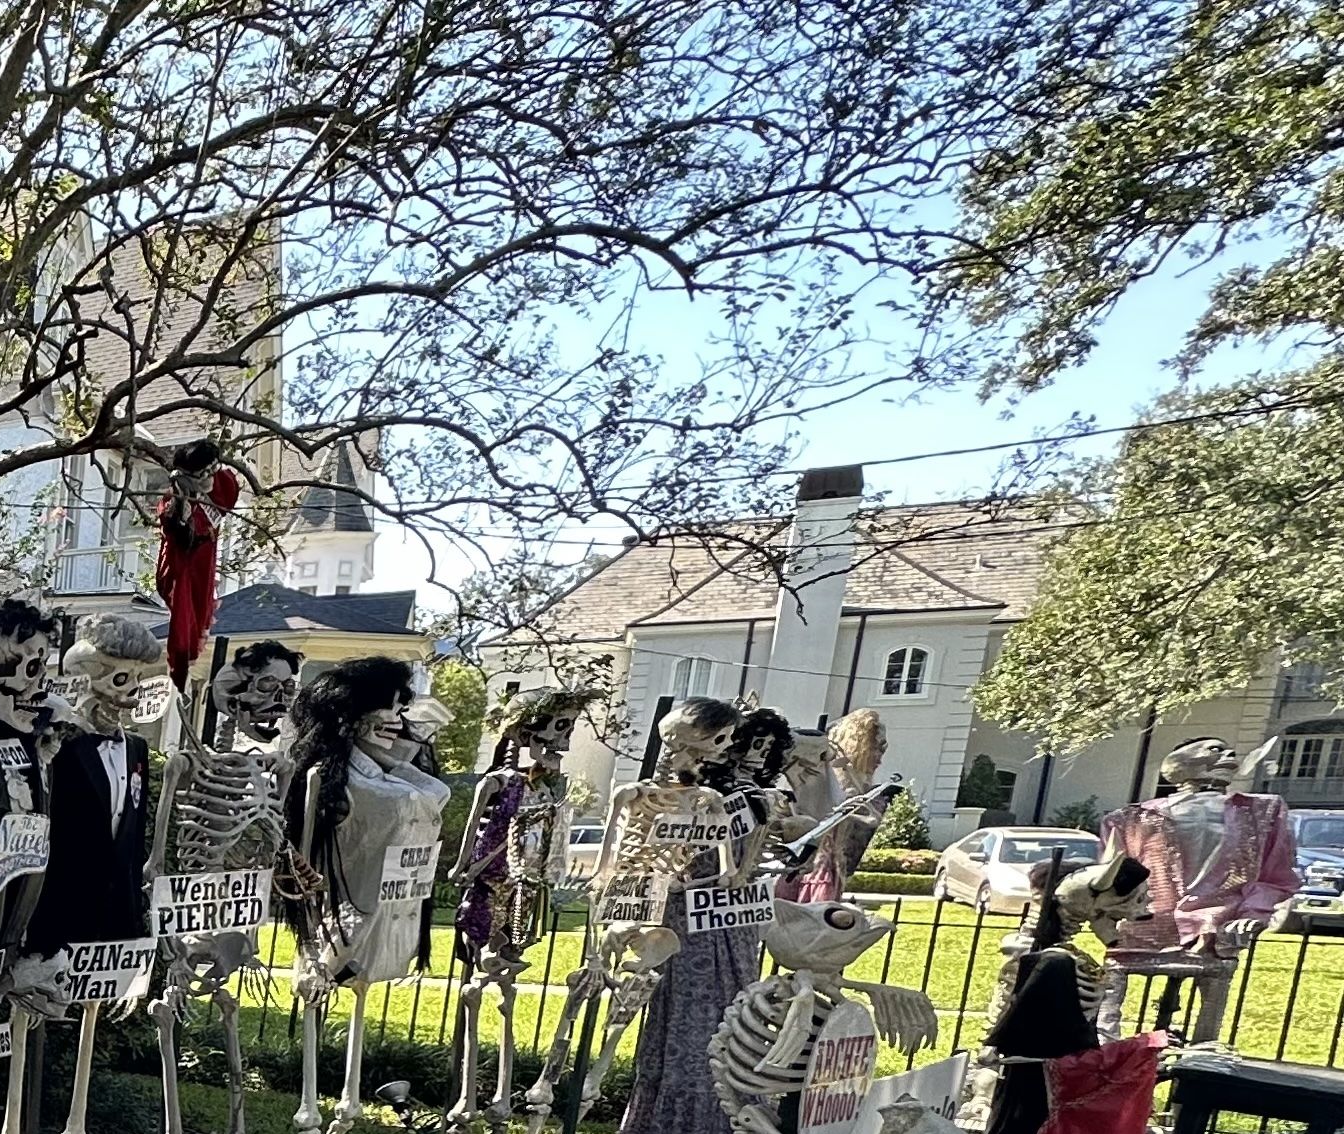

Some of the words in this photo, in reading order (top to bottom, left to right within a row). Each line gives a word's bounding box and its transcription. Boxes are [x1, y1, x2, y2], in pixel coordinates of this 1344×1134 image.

[654, 821, 728, 841] errnce
[169, 873, 258, 903] Wendell
[694, 884, 769, 910] DERMA
[158, 898, 263, 935] PIERCED
[690, 905, 773, 930] Thomas
